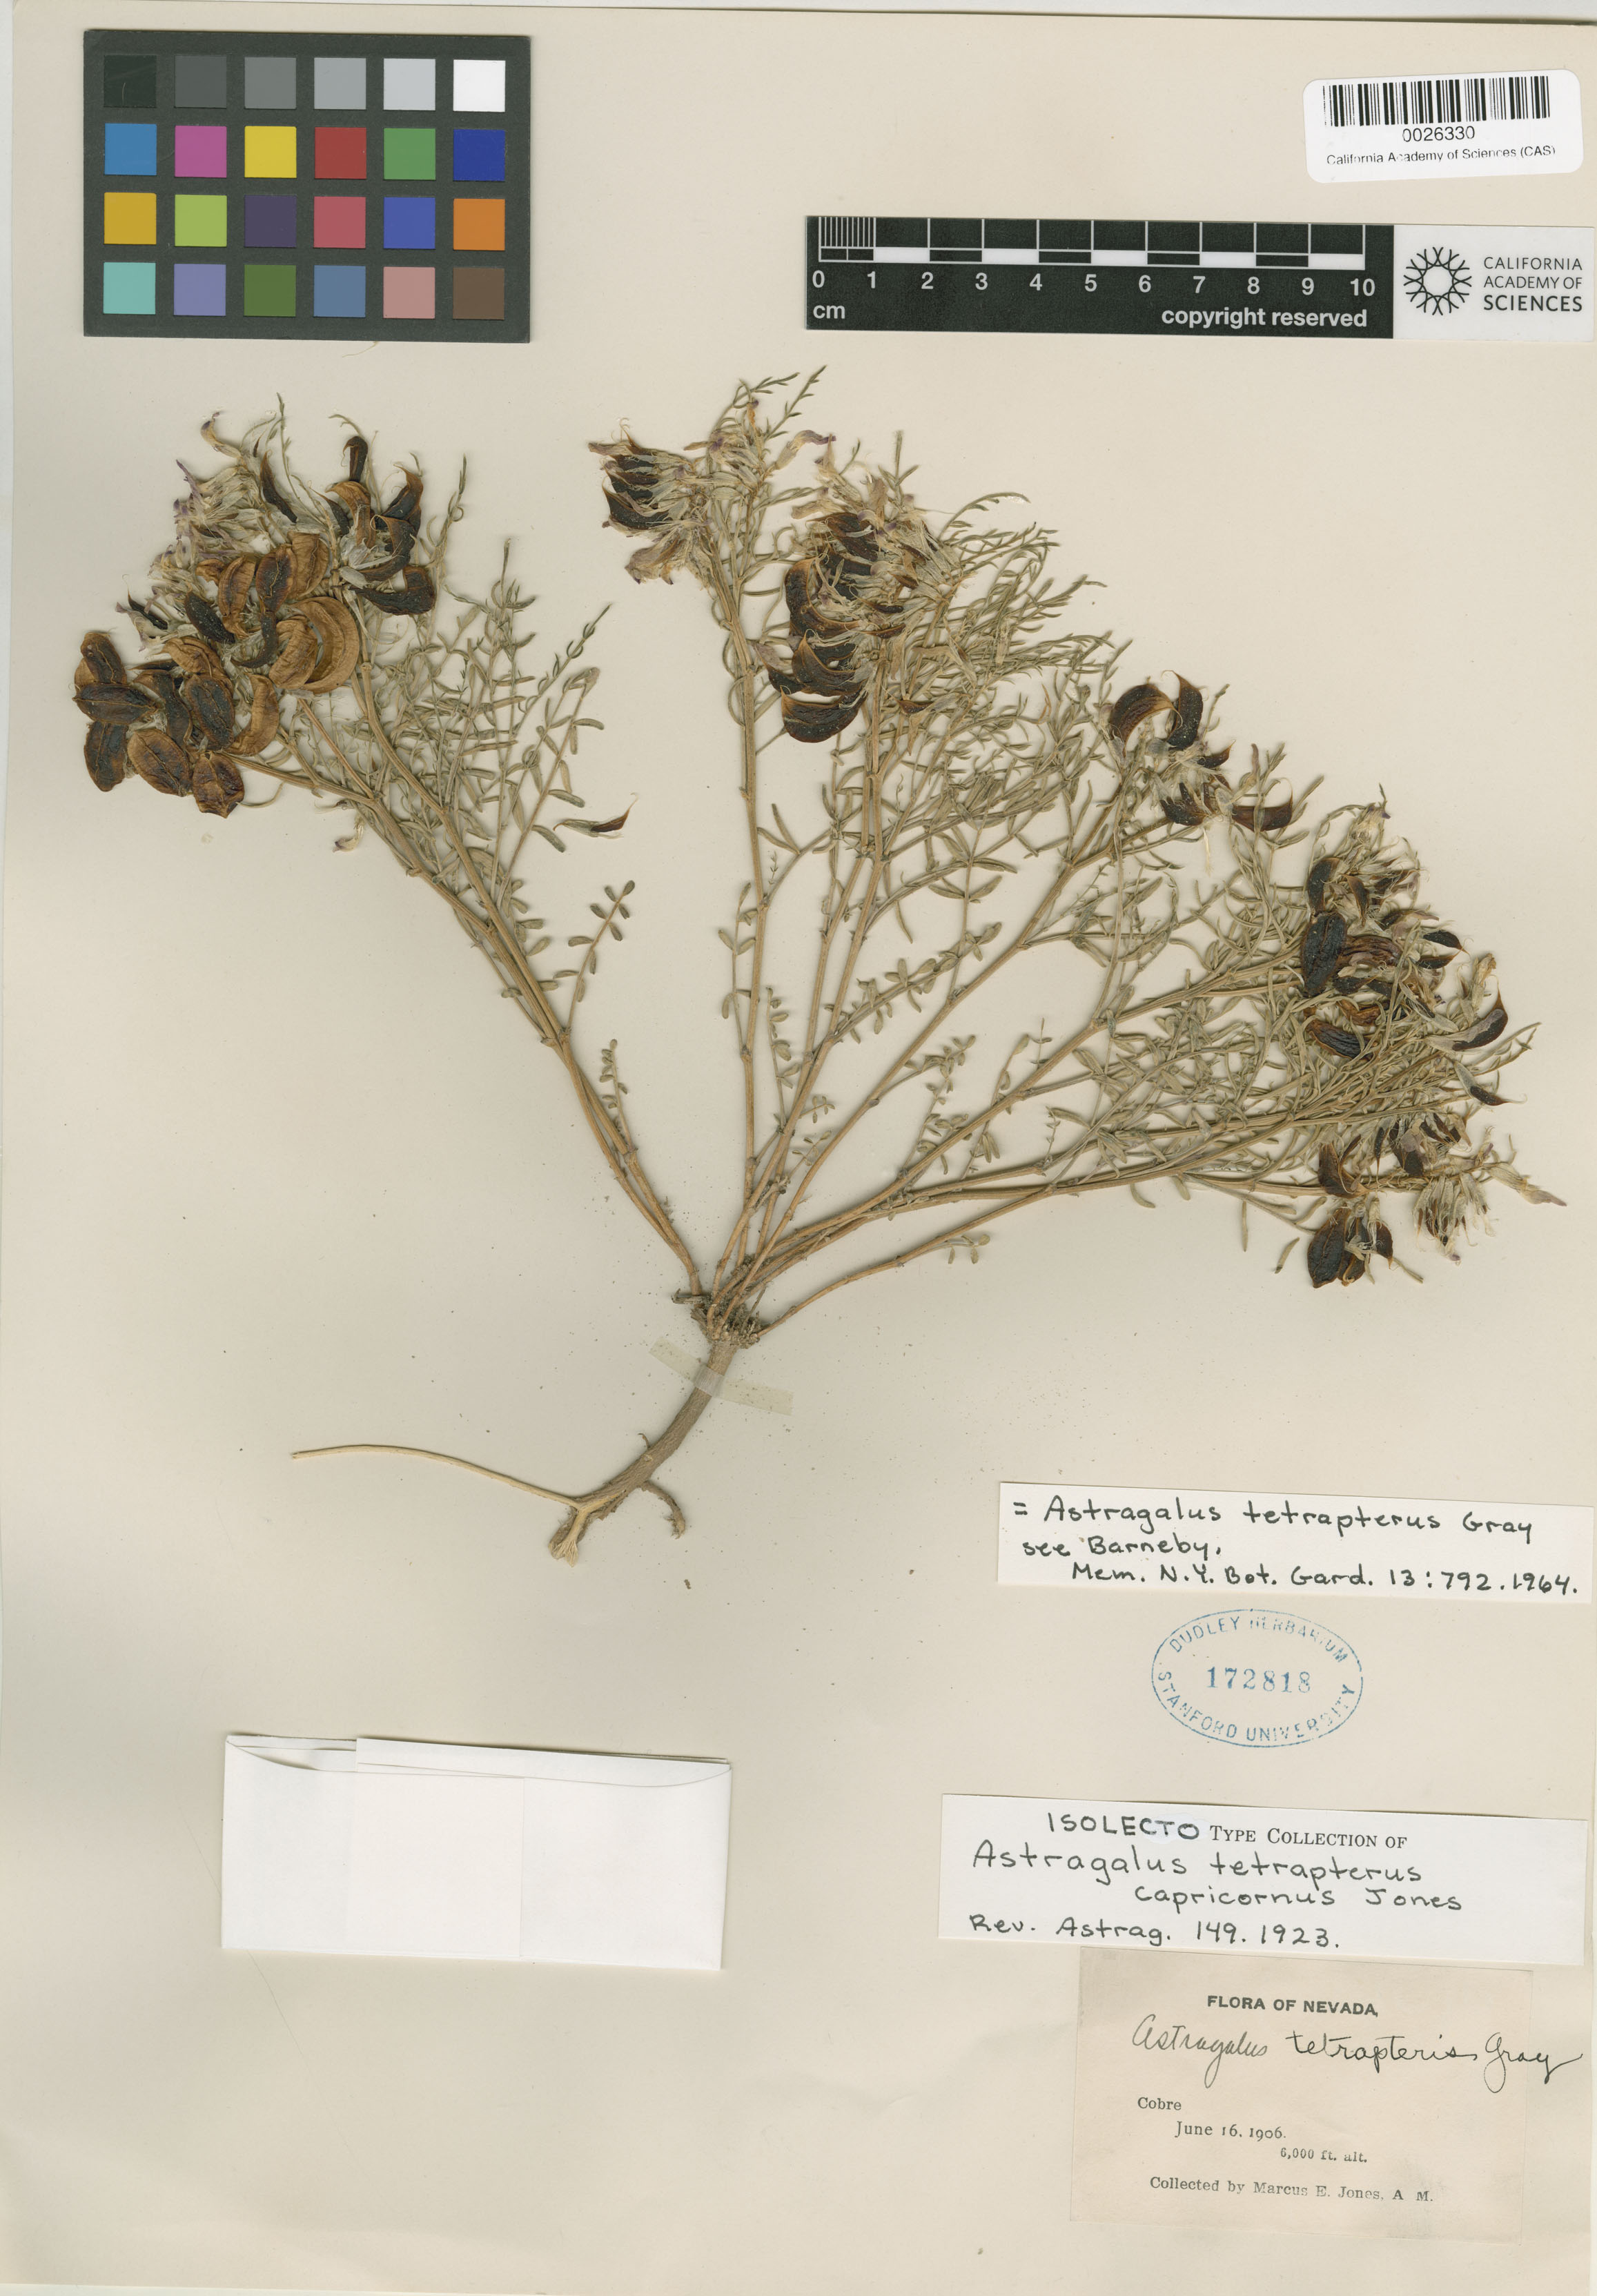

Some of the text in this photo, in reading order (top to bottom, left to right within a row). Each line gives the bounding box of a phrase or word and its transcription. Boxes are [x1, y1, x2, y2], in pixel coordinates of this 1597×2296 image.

[1403, 126, 1475, 142] 0026330
[1327, 146, 1555, 165] California Academy of Sciences (CAS)
[1485, 257, 1582, 270] CALIFORNIA
[812, 271, 1375, 296] 0 1 2 3 4 5 6 7 8 9 10
[1484, 276, 1582, 289] ACADEMY OF
[813, 305, 845, 319] cm
[1484, 295, 1582, 311] SCIENCES
[1162, 307, 1366, 329] copyright reserved
[1044, 1495, 1222, 1533] Astragalus
[1243, 1500, 1440, 1535] tetrapterus
[1462, 1514, 1532, 1544] Gray
[1023, 1542, 1070, 1557] see
[1072, 1562, 1145, 1582] Mem.
[1160, 1564, 1213, 1583] N.Y.
[1226, 1564, 1277, 1584] Bot.
[1291, 1564, 1373, 1586] Gard.
[1169, 1616, 1240, 1653] DUDLEY
[1206, 1666, 1311, 1694] 172818
[1157, 1671, 1355, 1742] STANFORD UNIVERSITY
[1048, 1813, 1199, 1840] ISOLECTO
[973, 1838, 1422, 1888] Astragalus tetrapterus
[1135, 1885, 1461, 1914] capricornus Jones
[970, 1914, 1035, 1933] Rev.
[1056, 1917, 1170, 1946] Astrag.
[1208, 1996, 1265, 2010] FLORA
[1273, 1999, 1296, 2011] OF
[1132, 2014, 1268, 2088] Astragalus
[1485, 2032, 1583, 2093] Gray
[1138, 2097, 1181, 2110] Cobre
[1175, 2121, 1213, 2137] June
[1249, 2126, 1287, 2141] 1906.
[1281, 2148, 1367, 2163] 6,000 ft. alt.
[1150, 2177, 1219, 2191] Collected
[1228, 2180, 1245, 2195] by
[1253, 2182, 1307, 2195] Marcus
[1315, 2185, 1331, 2197] E.
[1416, 2190, 1433, 2201] M.
